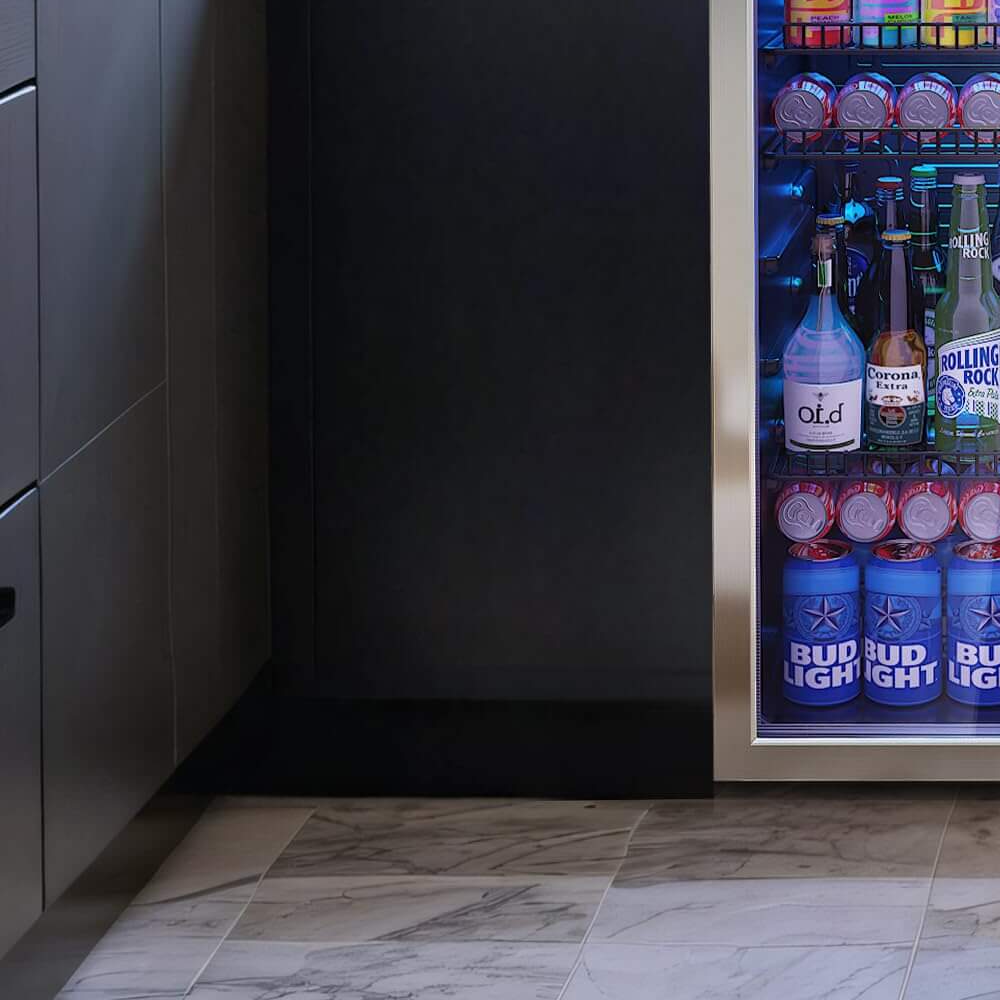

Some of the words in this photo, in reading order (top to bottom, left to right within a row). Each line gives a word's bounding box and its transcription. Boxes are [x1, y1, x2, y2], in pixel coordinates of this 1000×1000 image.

[962, 247, 990, 260] ROCK
[941, 344, 999, 372] ROLLING
[867, 366, 919, 381] Corona
[963, 367, 999, 386] ROCK
[875, 381, 908, 391] Extra
[789, 639, 858, 667] BUD
[864, 636, 927, 667] BUD
[783, 656, 861, 690] LIGHT
